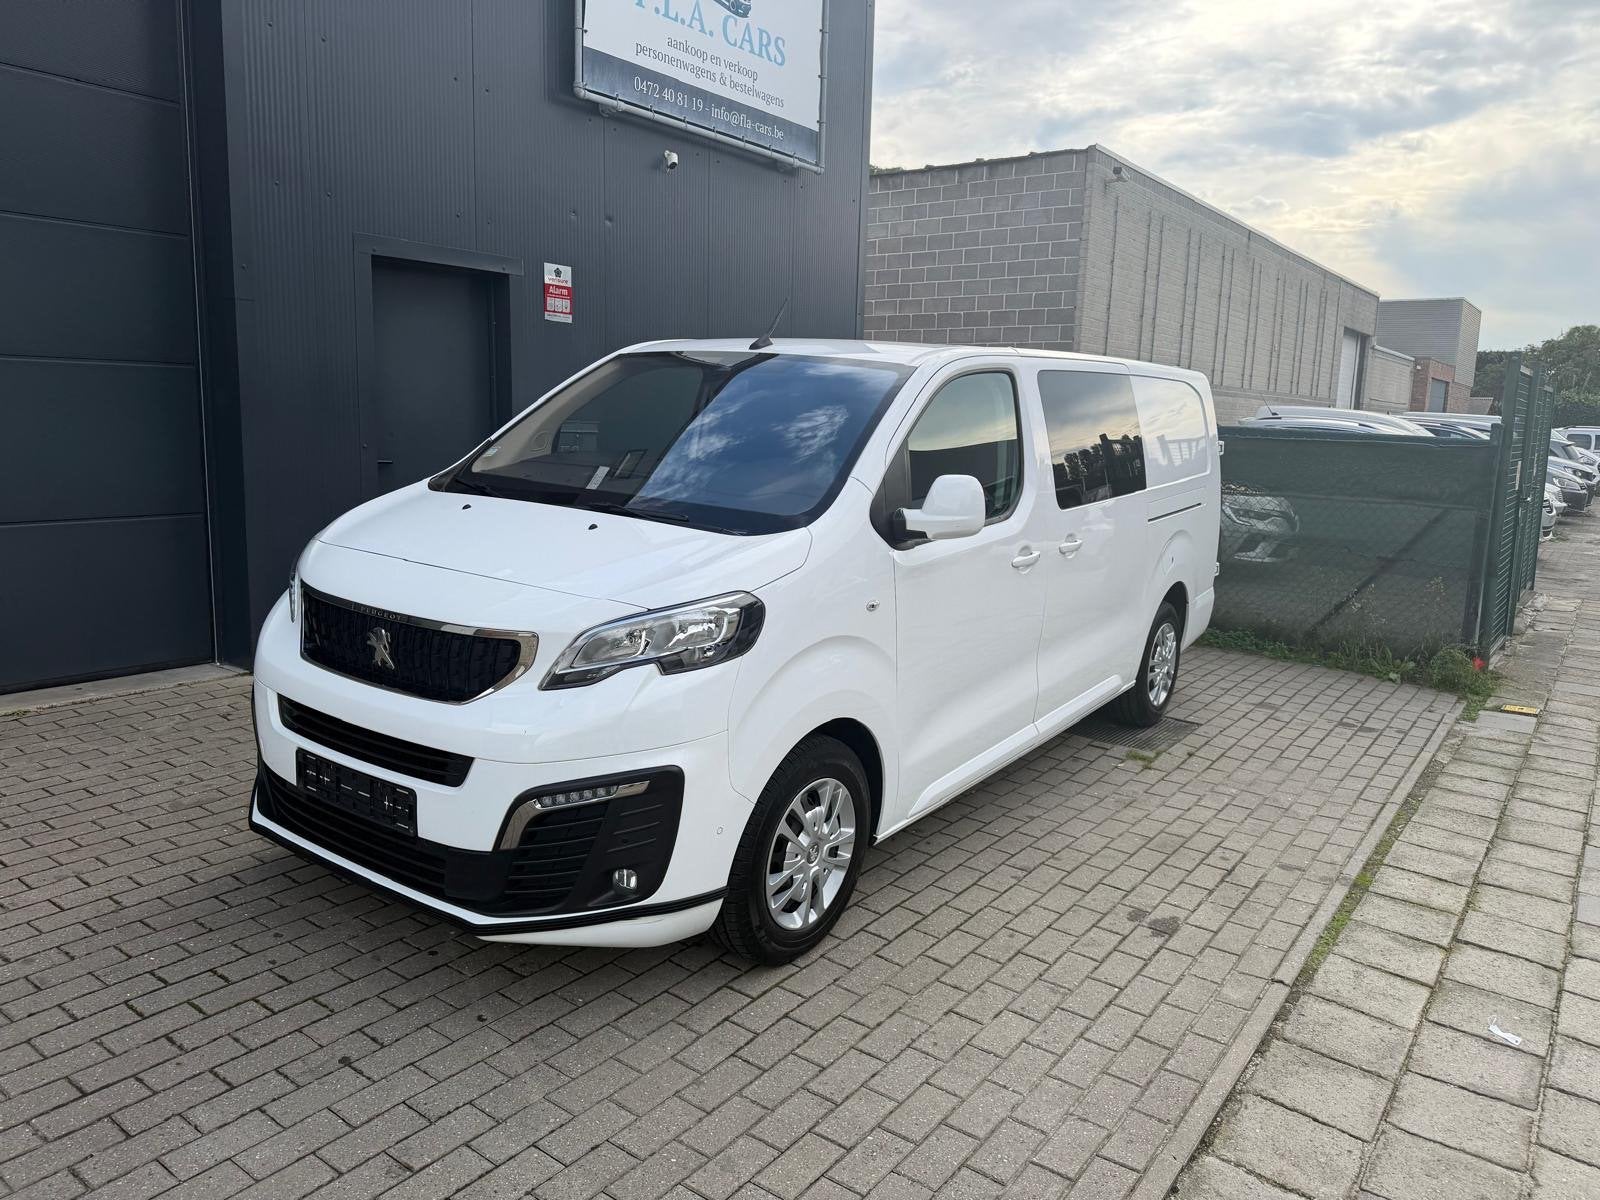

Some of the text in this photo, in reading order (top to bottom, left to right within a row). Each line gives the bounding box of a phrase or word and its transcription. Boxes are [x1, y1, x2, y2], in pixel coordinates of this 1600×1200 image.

[635, 0, 785, 66] .L.A. CARS
[667, 37, 758, 84] aankoop en verkoop
[635, 42, 785, 108] personenwagens & bestelwagens
[634, 76, 660, 98] 0472
[662, 88, 675, 103] 40
[677, 92, 688, 108] 81
[692, 97, 703, 112] 19
[711, 103, 784, 140] info@fla-cars.be
[549, 286, 568, 296] Alarm
